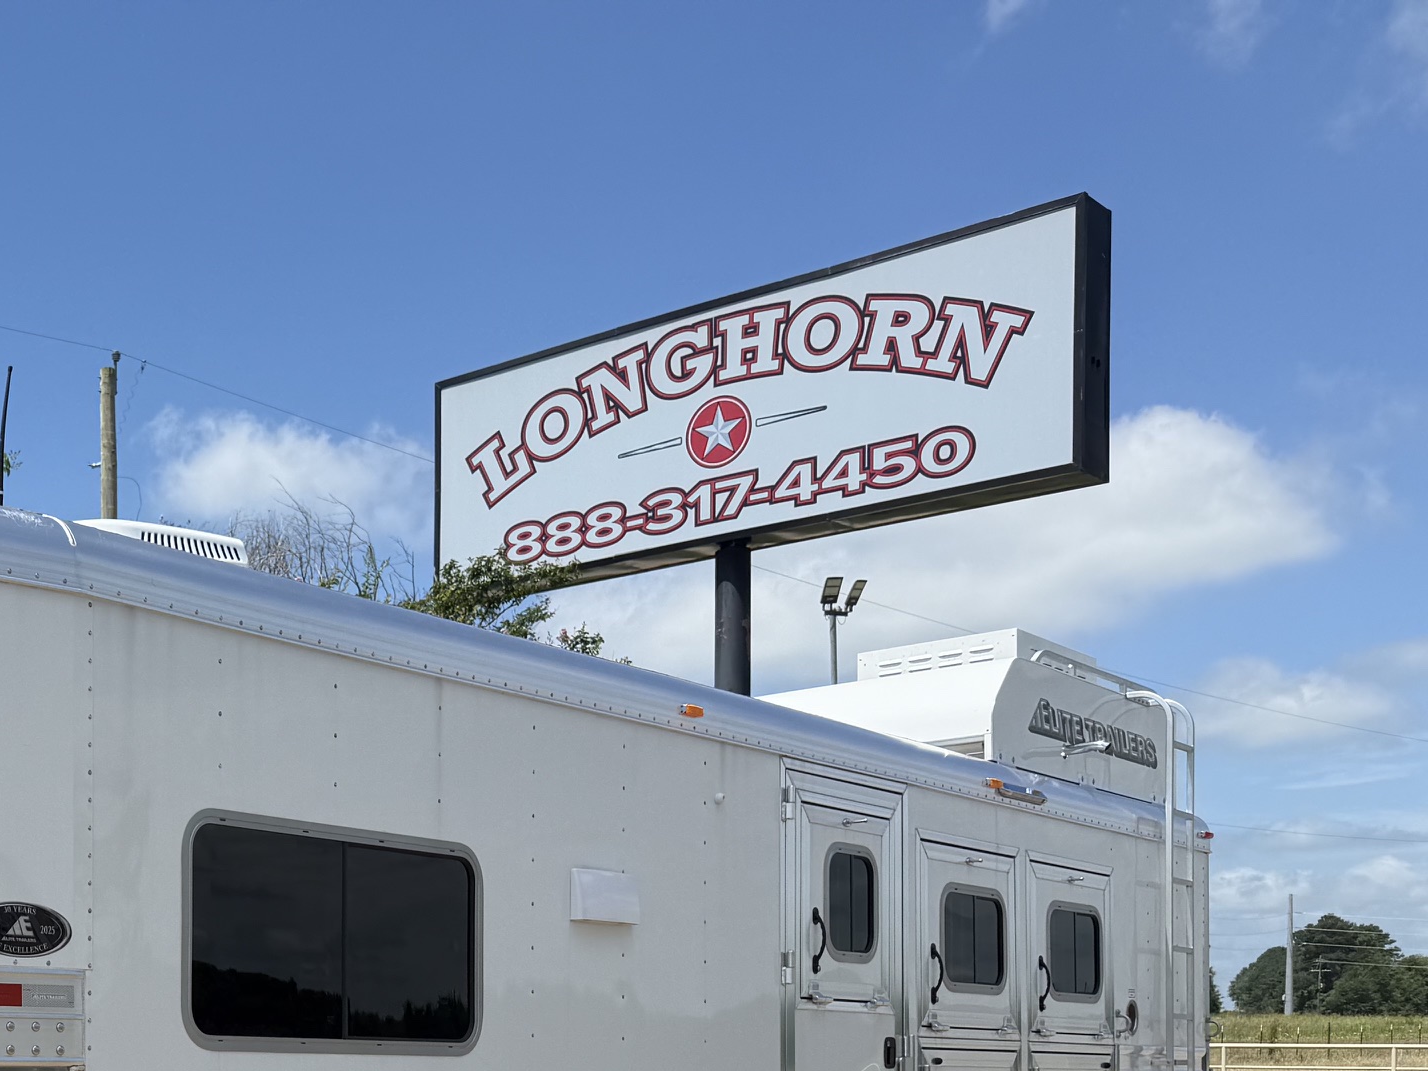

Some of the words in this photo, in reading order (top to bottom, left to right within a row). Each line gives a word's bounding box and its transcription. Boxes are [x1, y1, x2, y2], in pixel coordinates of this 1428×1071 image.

[466, 292, 1034, 507] LONGHORN
[504, 425, 976, 564] 888-317-4450
[13, 906, 37, 915] YEARS
[40, 925, 56, 935] 2025
[3, 943, 49, 954] EXCELLENCE
